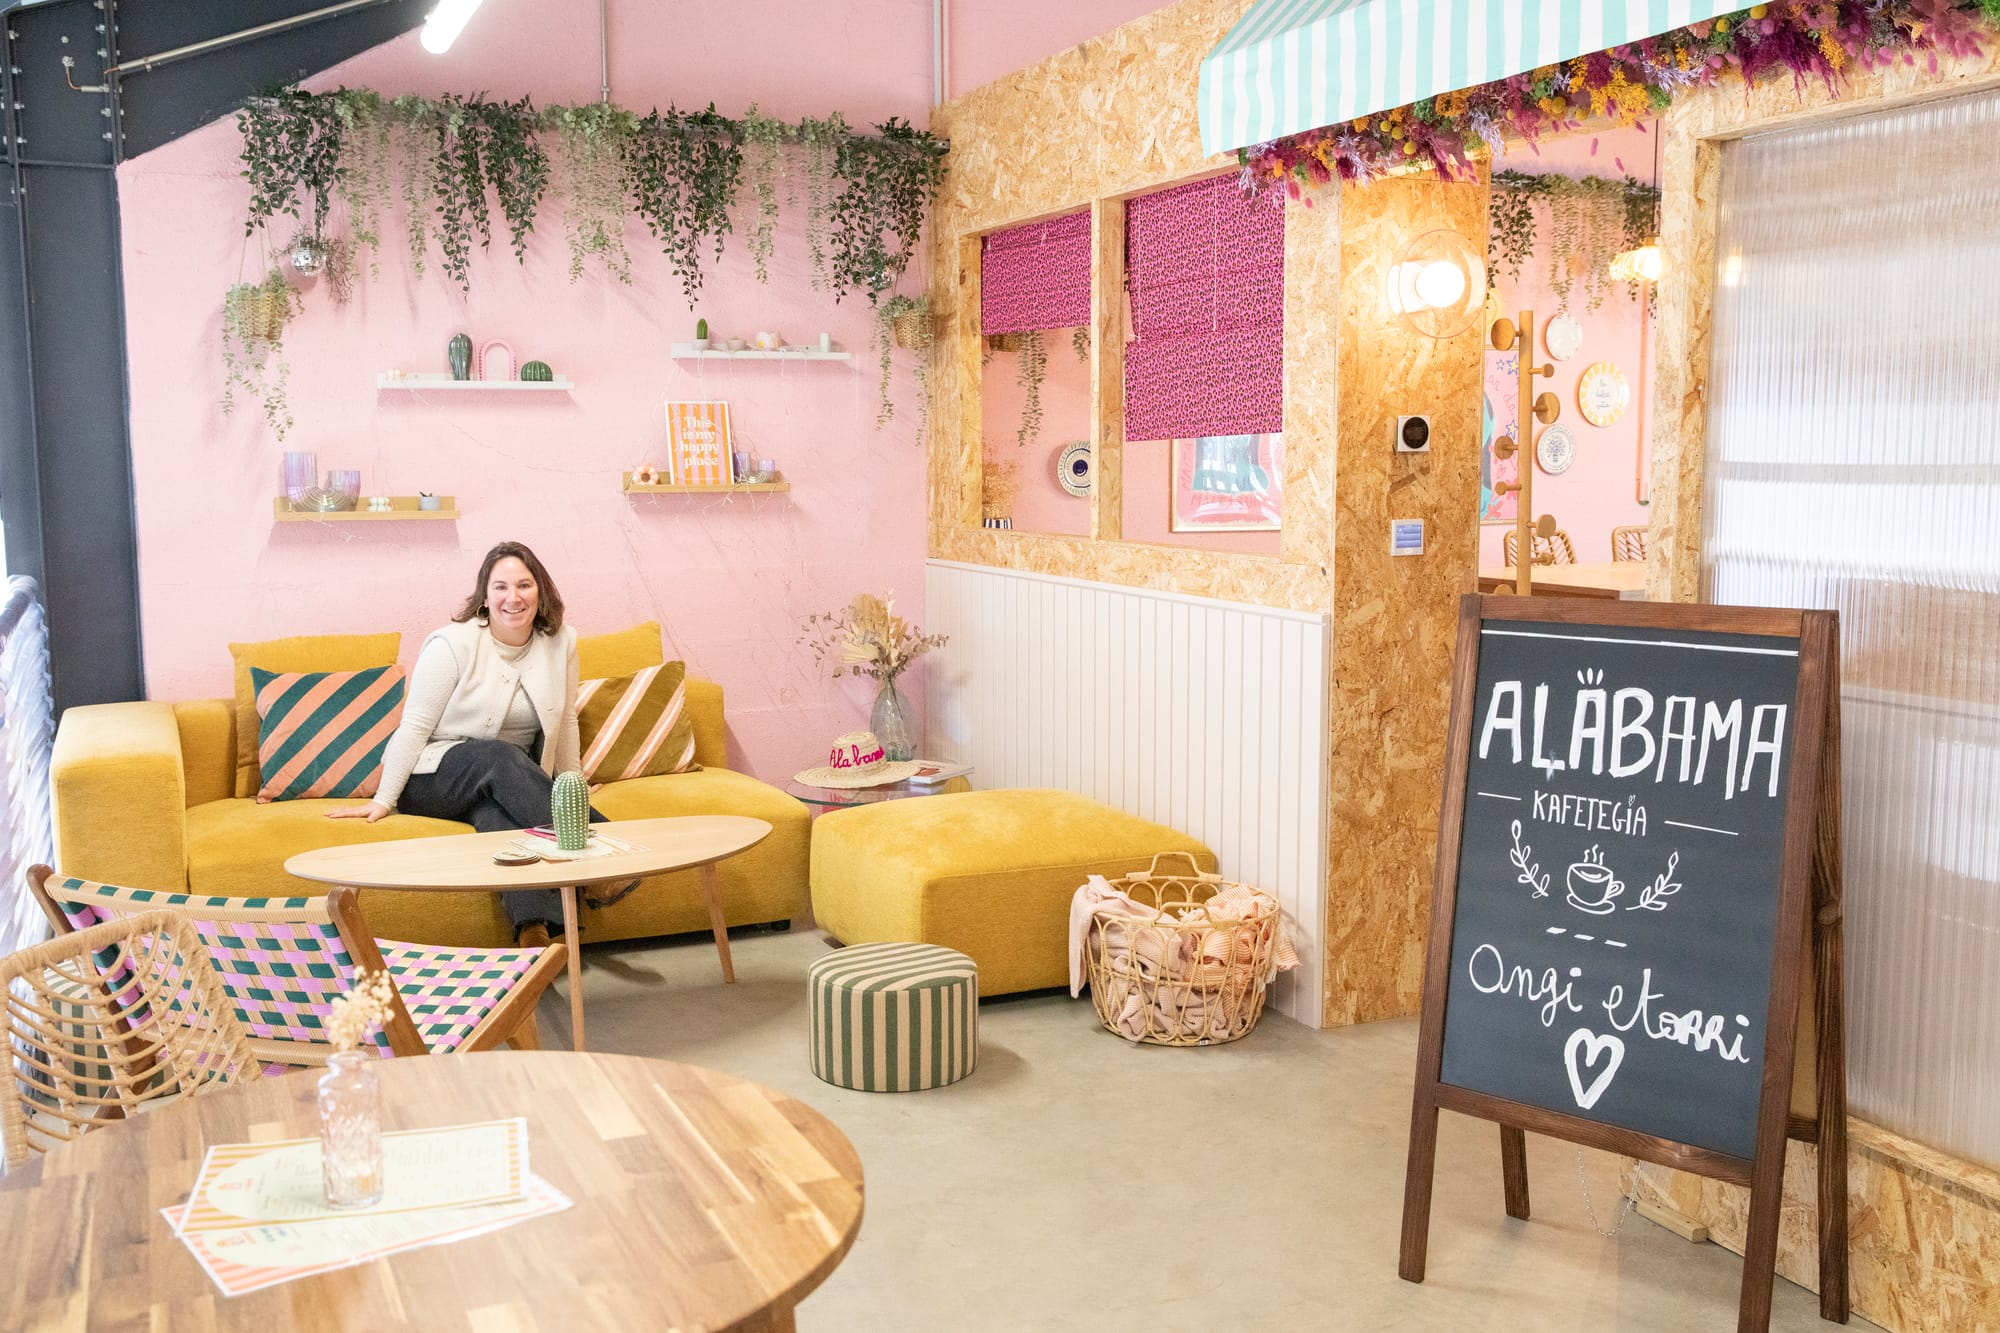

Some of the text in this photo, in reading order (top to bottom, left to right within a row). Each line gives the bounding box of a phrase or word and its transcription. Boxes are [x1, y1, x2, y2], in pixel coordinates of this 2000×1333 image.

[684, 416, 712, 430] This
[683, 428, 715, 443] is my
[680, 441, 720, 456] happy
[685, 456, 719, 469] place
[1478, 680, 1788, 800] ALABAMA
[1532, 790, 1648, 837] KAFETEGIA
[1469, 944, 1583, 1027] Ongi
